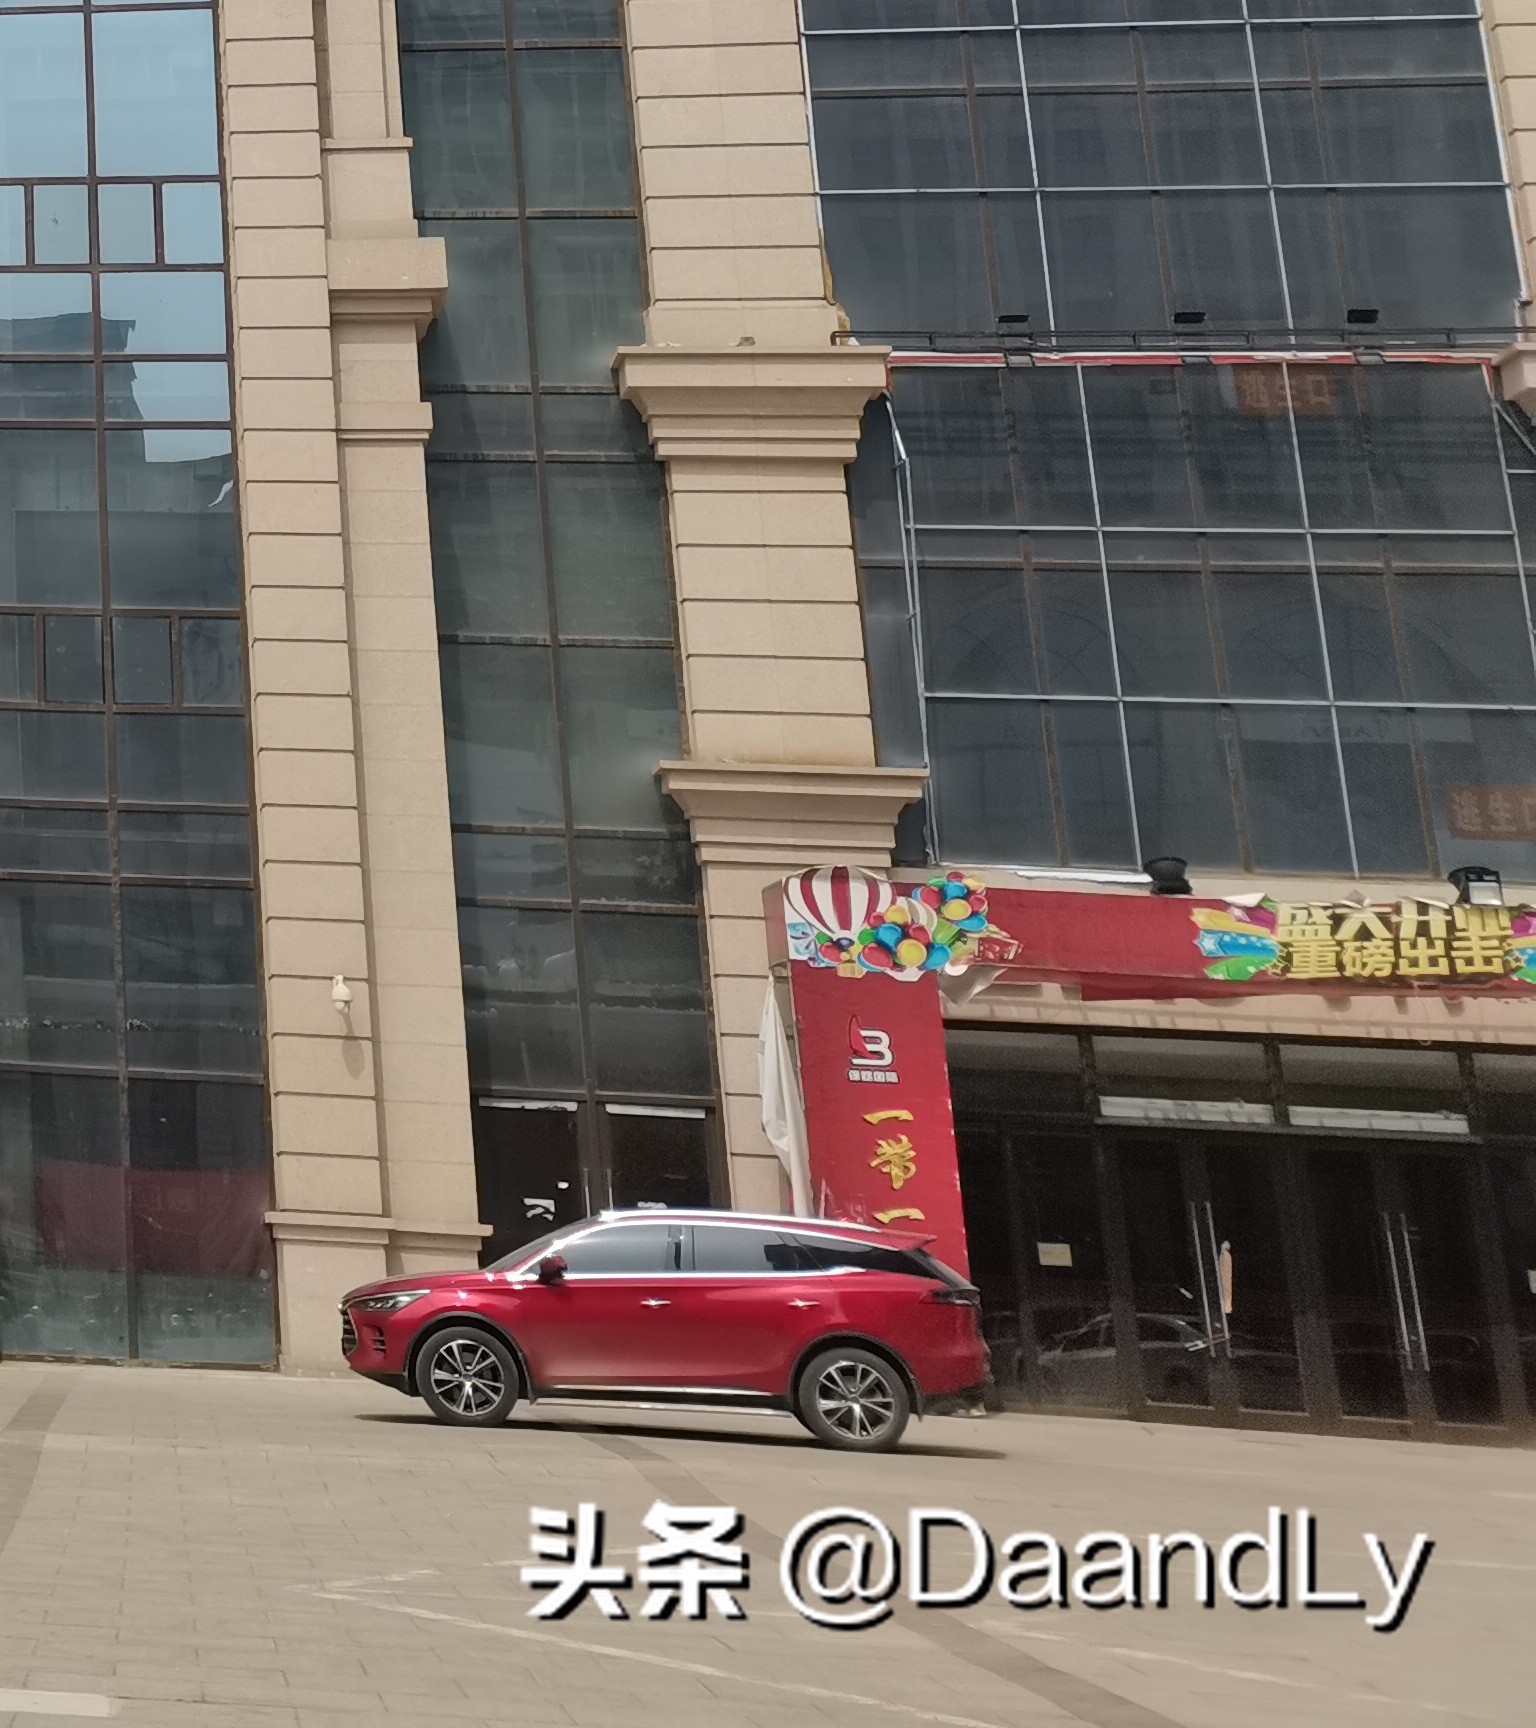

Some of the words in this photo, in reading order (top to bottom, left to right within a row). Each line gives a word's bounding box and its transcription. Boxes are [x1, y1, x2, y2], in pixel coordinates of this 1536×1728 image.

[1277, 897, 1514, 942] 盛大开业
[1286, 938, 1505, 978] 重磅出击
